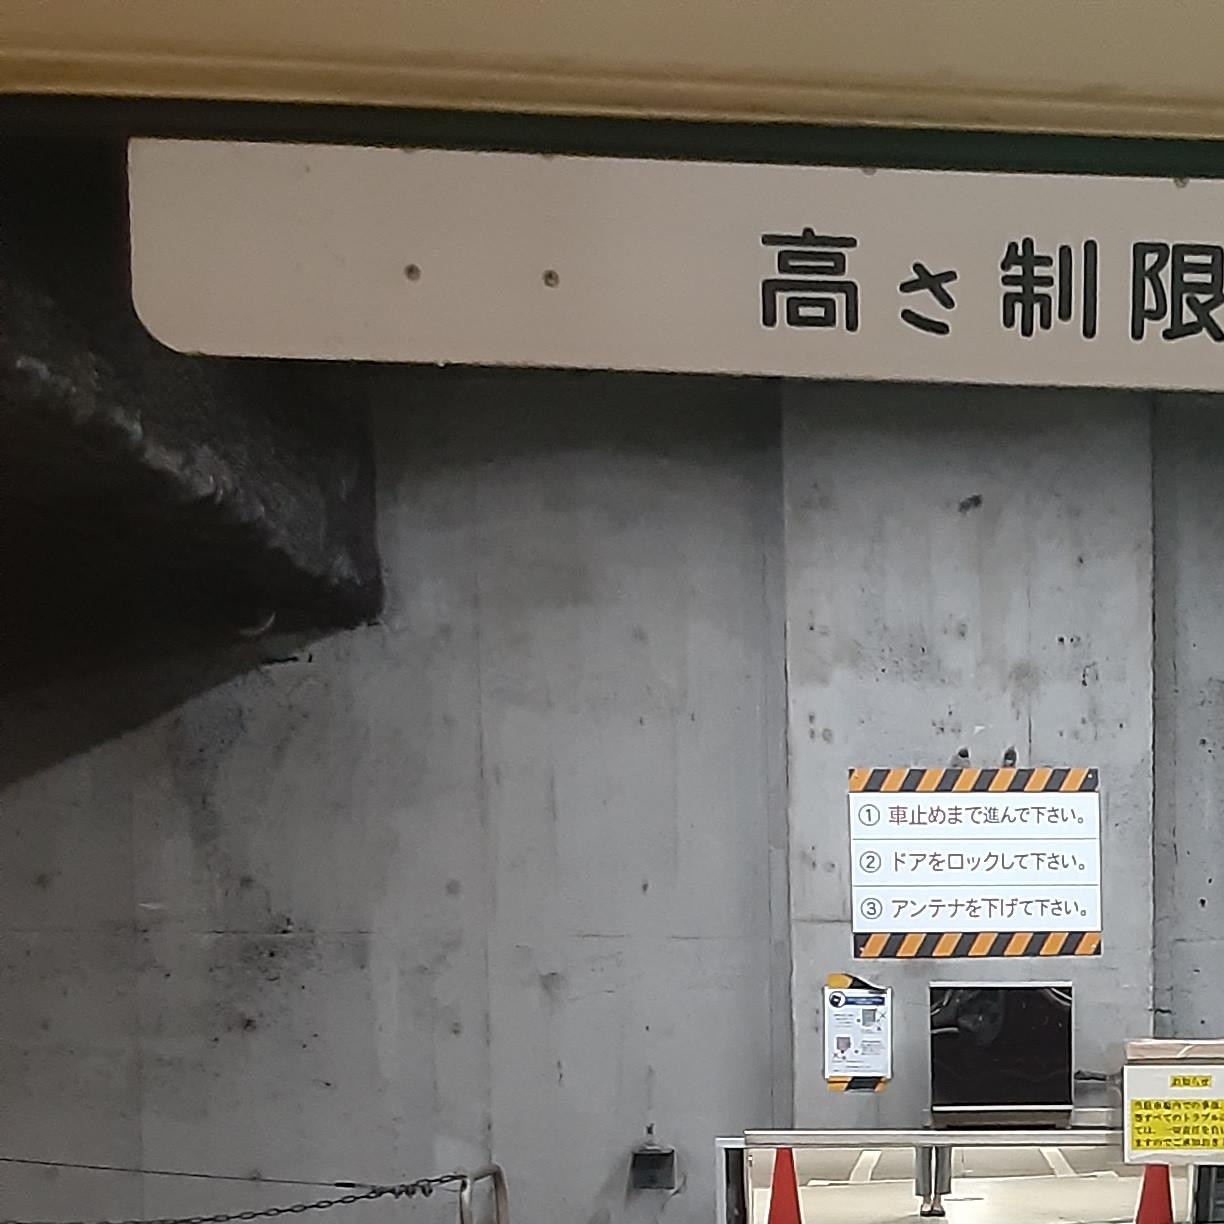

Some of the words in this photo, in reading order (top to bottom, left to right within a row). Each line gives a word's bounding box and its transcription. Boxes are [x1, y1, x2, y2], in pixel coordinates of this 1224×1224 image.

[888, 804, 1084, 825] 車止めまで進んで下さい。
[893, 851, 1085, 872] ドアをロックして下さい。
[892, 898, 1087, 918] アンテナを下げて下さい。
